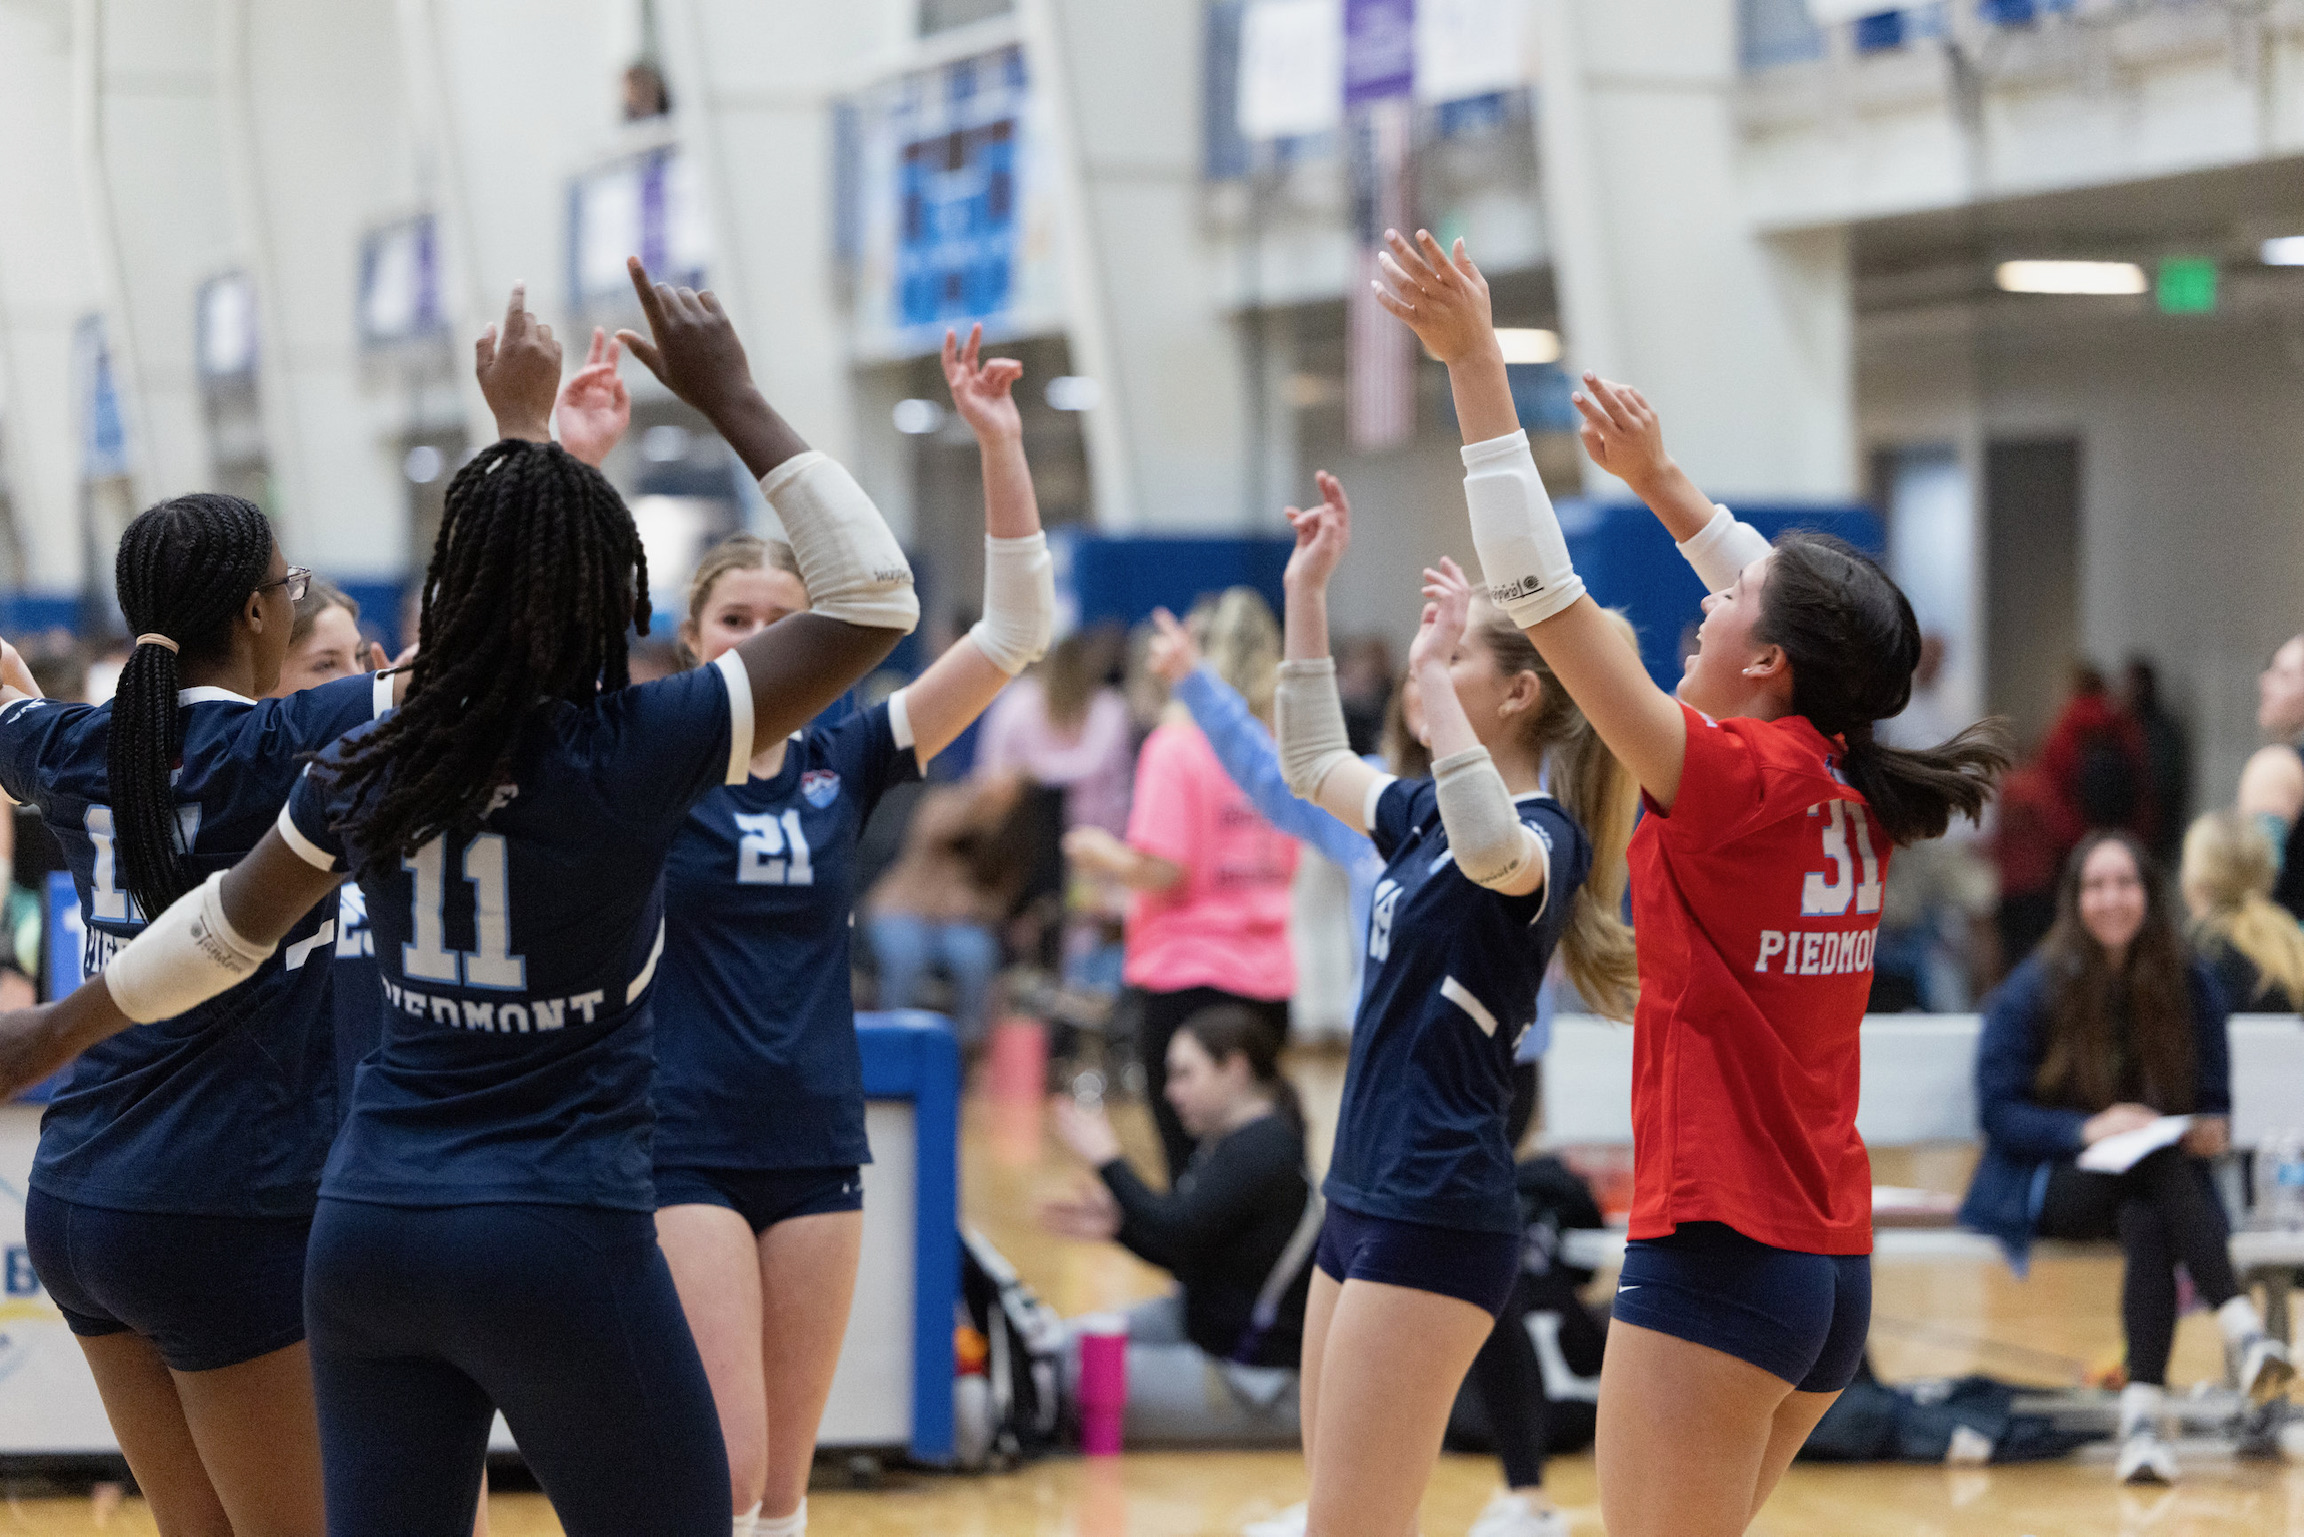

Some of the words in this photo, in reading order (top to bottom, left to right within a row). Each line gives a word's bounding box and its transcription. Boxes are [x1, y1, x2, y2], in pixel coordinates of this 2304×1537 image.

[734, 808, 814, 886] 21
[1800, 798, 1882, 917] 31
[401, 829, 527, 992] 11
[380, 973, 604, 1033] IEDMONT
